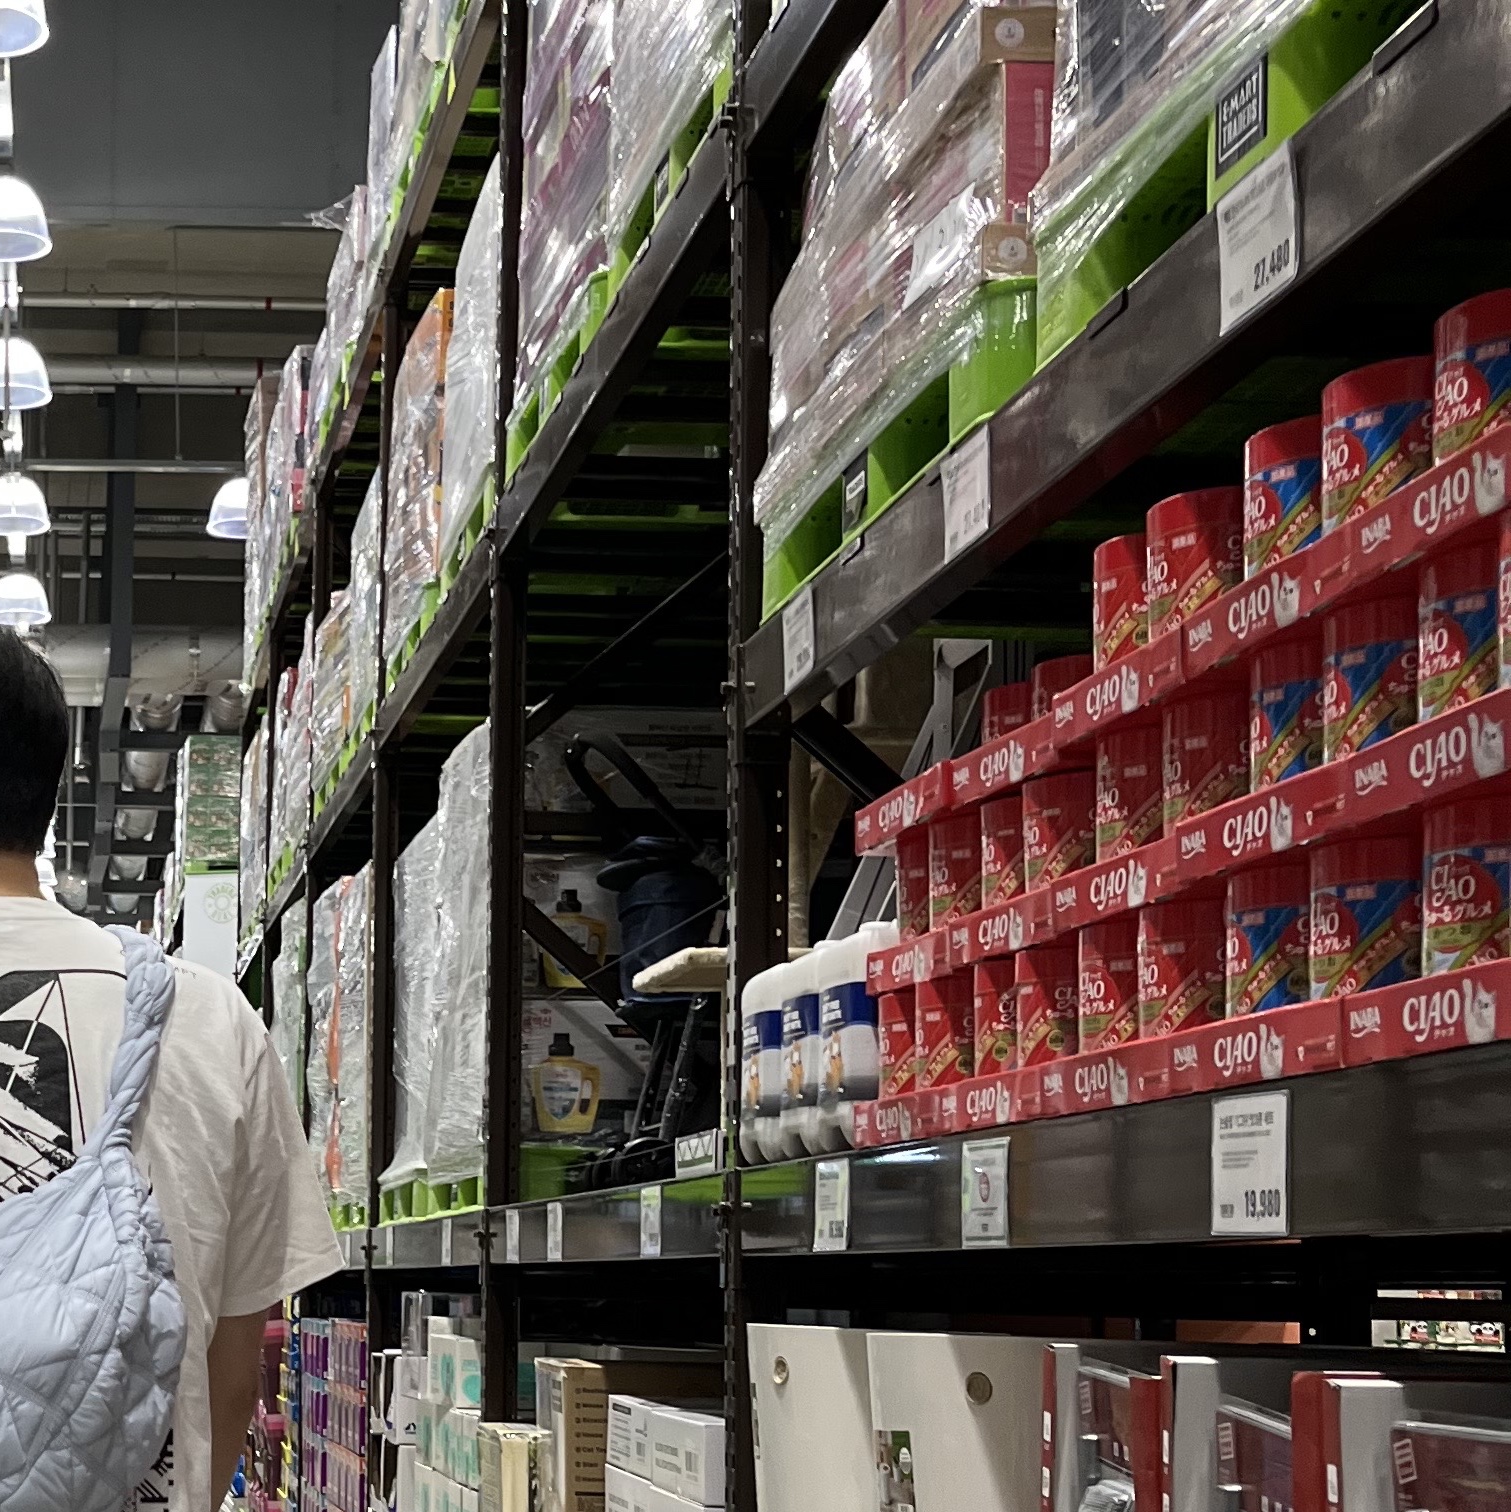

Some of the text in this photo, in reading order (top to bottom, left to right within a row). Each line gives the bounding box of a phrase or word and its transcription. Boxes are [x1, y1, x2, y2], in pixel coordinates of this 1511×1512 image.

[1413, 467, 1470, 534] CIAO
[1228, 585, 1270, 640] CIAO
[1086, 673, 1120, 721] CIAO
[980, 748, 1008, 786] CIAO
[1409, 726, 1467, 787] CIAO
[878, 796, 903, 832] CIAO
[1223, 806, 1268, 856] CIAO
[1090, 867, 1127, 911] CIAO
[978, 914, 1010, 950] CIAO
[892, 950, 914, 983] CIAO
[1402, 983, 1461, 1043] CIAO
[1213, 1031, 1258, 1077] CIAO
[966, 1087, 996, 1122] CIAO
[1074, 1063, 1108, 1103] CIAO
[1245, 1189, 1281, 1221] 19,980
